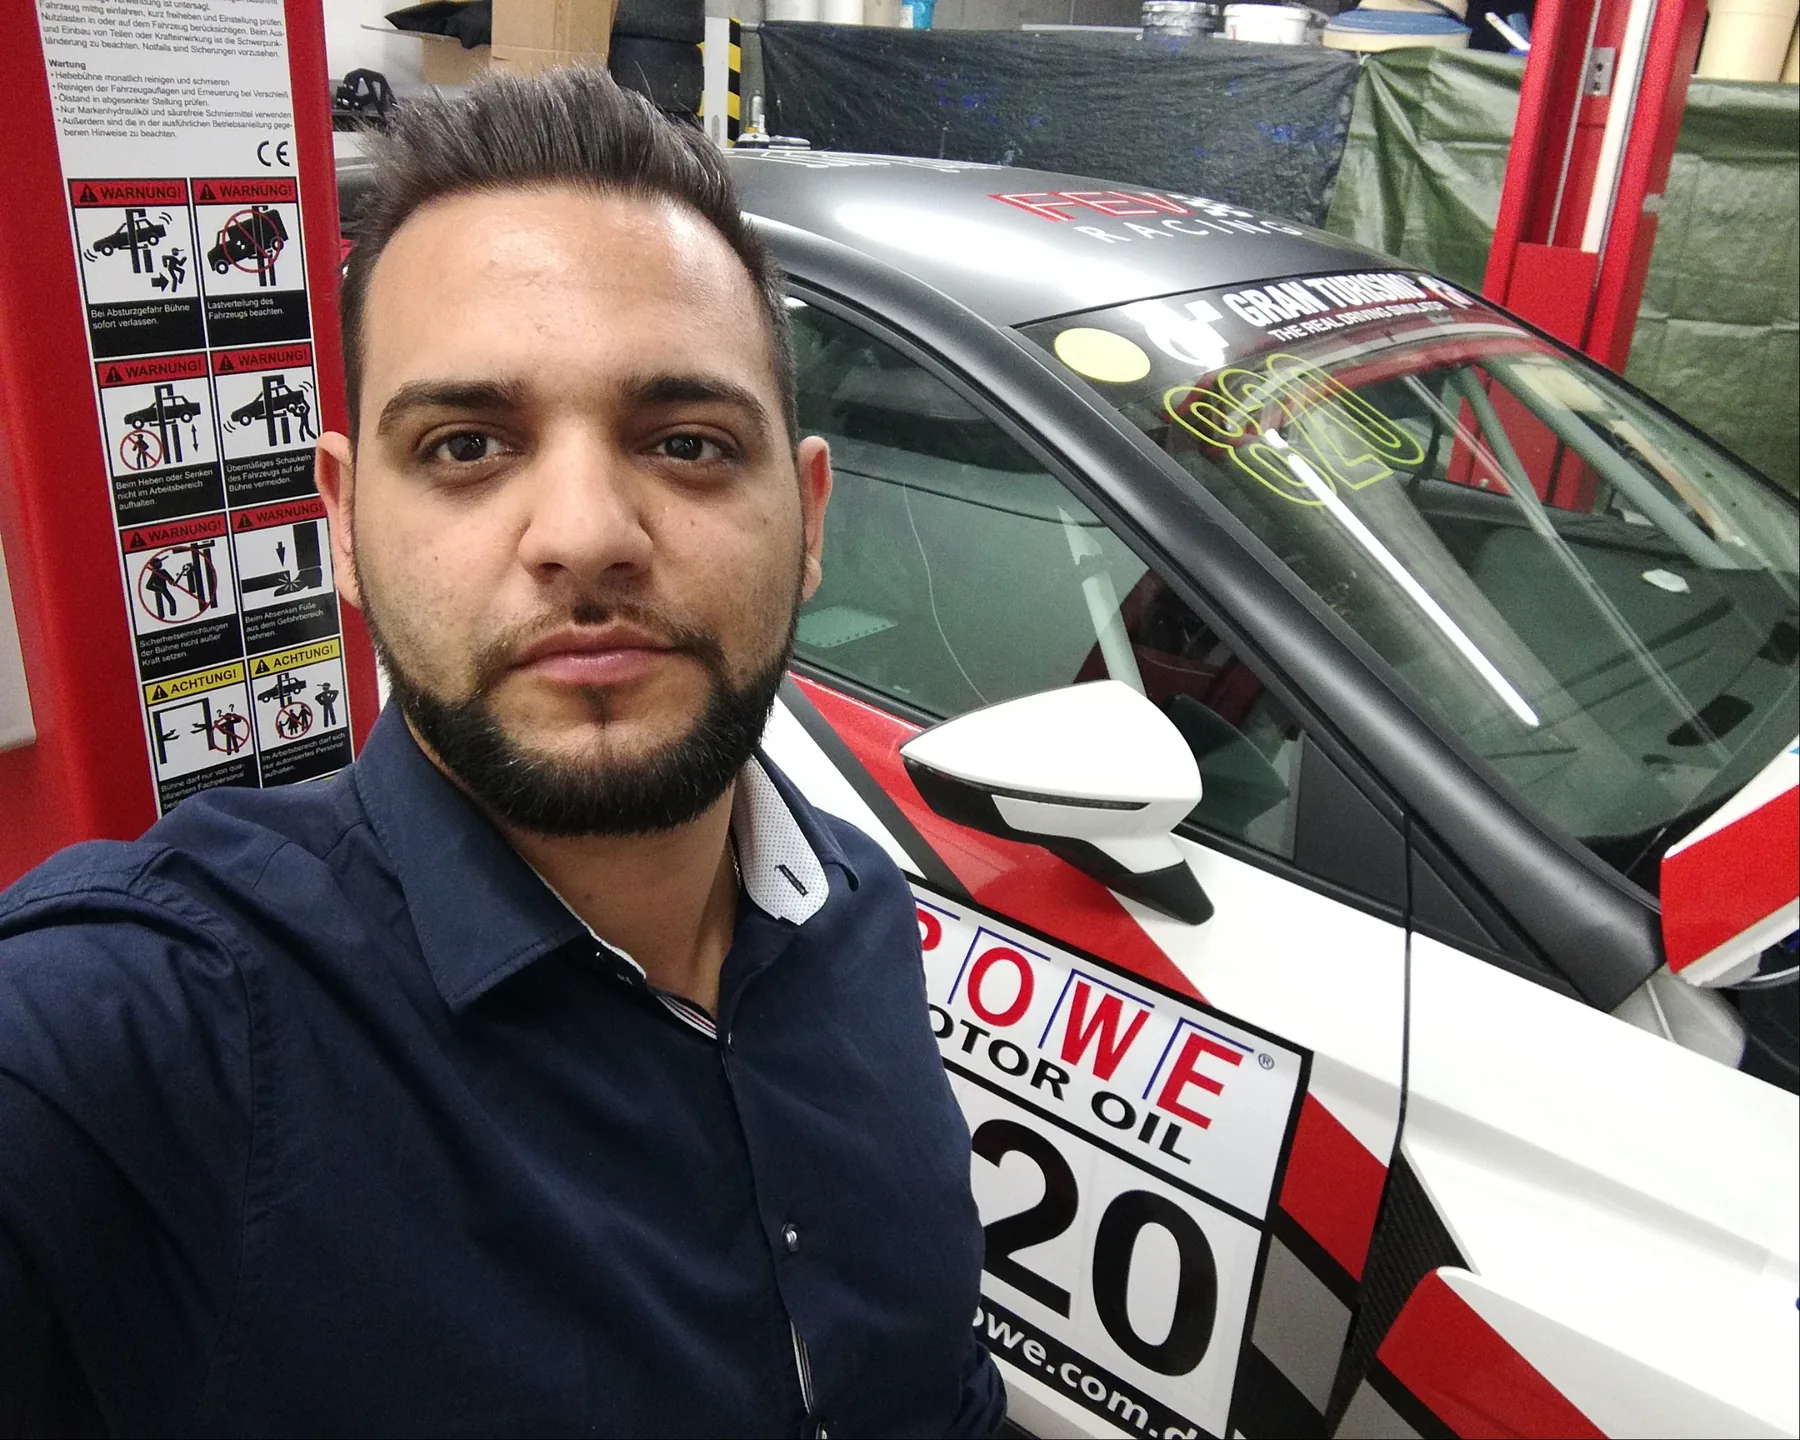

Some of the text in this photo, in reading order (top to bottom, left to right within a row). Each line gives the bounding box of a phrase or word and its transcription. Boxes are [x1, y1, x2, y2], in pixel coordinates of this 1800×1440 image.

[40, 2, 79, 12] Fahrzeug
[148, 10, 164, 18] kurz
[166, 11, 201, 20] freiheben
[203, 14, 217, 22] und
[220, 15, 258, 26] Einstellung
[41, 12, 86, 23] Nutzlasten
[88, 16, 96, 24] in
[98, 17, 116, 25] oder
[118, 18, 131, 26] auf
[133, 20, 150, 28] dem
[152, 21, 188, 32] Fahrzeug
[43, 25, 59, 33] und
[61, 26, 90, 35] Einbau
[109, 29, 133, 38] Teilen
[135, 32, 152, 40] oder
[155, 32, 212, 44] Krafteinwirkung
[142, 43, 171, 52] Notfalls
[190, 45, 236, 56] Sicherungen
[48, 59, 86, 70] Wartung
[56, 71, 103, 80] Hebebühne
[105, 74, 143, 83] monatlich
[144, 76, 175, 85] reinigen
[193, 78, 230, 86] schmieren
[57, 83, 94, 93] Reinigen
[96, 85, 108, 93] der
[111, 85, 180, 96] Fahrzeugauflagen
[181, 88, 195, 96] und
[197, 88, 239, 98] Erneuerung
[58, 92, 90, 102] Ölstand
[102, 96, 150, 105] abgesenkter
[152, 97, 182, 107] Stellung
[60, 105, 75, 113] Nur
[77, 106, 149, 116] Markenhydrauliköl
[151, 108, 165, 116] und
[167, 109, 203, 117] säurefreie
[205, 110, 253, 118] Schmiermittel
[62, 117, 105, 125] Außerdem
[107, 118, 123, 126] sind
[125, 118, 137, 126] die
[148, 119, 160, 127] der
[162, 120, 211, 128] ausführlichen
[212, 120, 272, 130] Betriebsanleitung
[64, 128, 89, 137] benen
[91, 129, 127, 137] Hinweise
[257, 140, 290, 167] CE
[101, 186, 181, 200] WARNUNG!
[220, 184, 292, 197] WARNUNG!
[1074, 219, 1302, 244] RACING
[207, 299, 259, 309] Lastverteilung
[1222, 273, 1428, 327] GRAN TURISMO
[91, 304, 190, 318] Bei Absturzgefahr Bühne
[209, 308, 284, 320] Fahrzeugs beachten.
[93, 318, 159, 329] sofort verlassen.
[1268, 326, 1307, 343] THE
[1303, 315, 1346, 340] REAL
[1343, 305, 1395, 327] DRIVING
[238, 350, 307, 366] WARNUNG!
[126, 360, 201, 379] WARNUNG!
[1164, 353, 1425, 506] 820
[226, 454, 311, 473] Übermäßiges Schaukeln
[116, 469, 213, 490] Beim Heben oder Senken
[228, 464, 305, 483] des Fahrzeugs auf der
[117, 481, 203, 500] nicht im Arbeitsbereich
[229, 476, 292, 492] Bühne vermeiden.
[119, 499, 157, 511] aufhalten.
[256, 502, 324, 522] WARNUNG!
[149, 520, 221, 542] WARNUNG!
[245, 614, 263, 624] Beim
[264, 606, 298, 619] Absenken
[246, 609, 324, 633] aus dem Gefahrbereich
[140, 622, 228, 648] Sicherheitseinrichtungen
[155, 643, 179, 654] Bühne
[181, 638, 198, 648] nicht
[200, 633, 221, 644] außer
[142, 651, 188, 666] Kraft setzen.
[273, 645, 334, 668] ACHTUNG!
[170, 669, 237, 694] ACHTUNG!
[262, 732, 346, 762] Im Arbeitsbereich darf sich
[263, 741, 343, 770] nur autorisiertes Personal
[161, 781, 185, 792] Bühne
[186, 775, 200, 784] darf
[201, 772, 213, 780] nur
[214, 767, 228, 776] von
[198, 771, 244, 790] Fachpersonal
[1090, 1091, 1190, 1164] OIL
[970, 1119, 1218, 1377] 20
